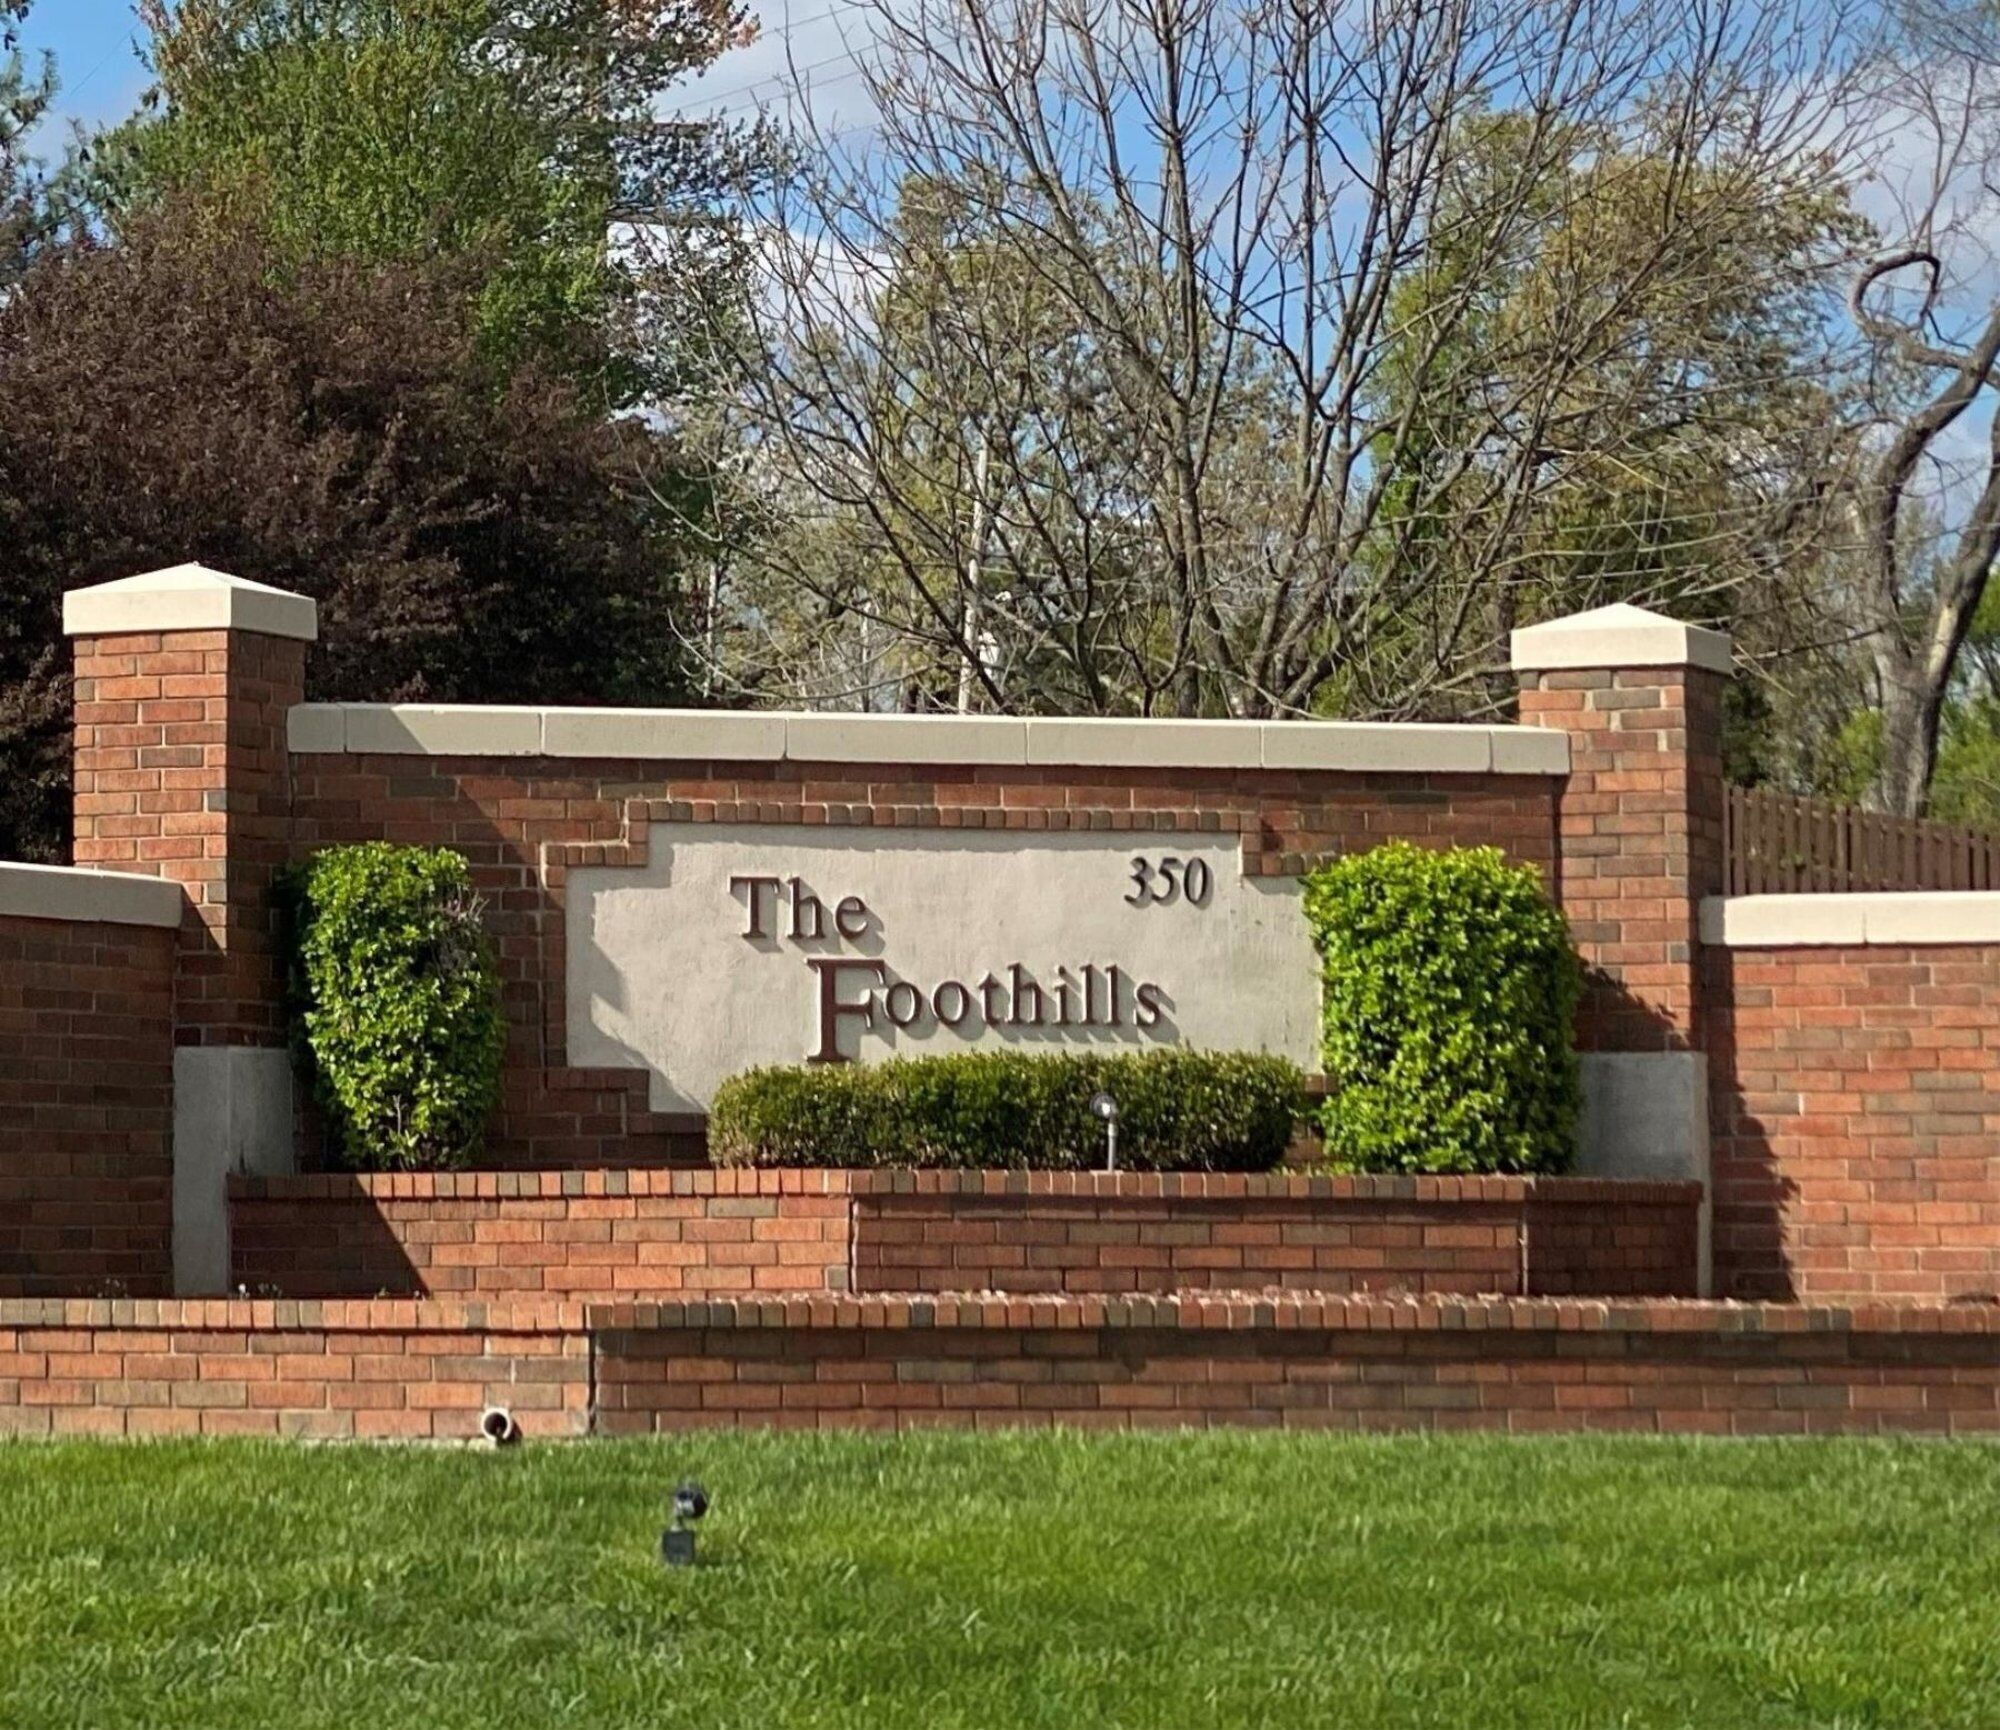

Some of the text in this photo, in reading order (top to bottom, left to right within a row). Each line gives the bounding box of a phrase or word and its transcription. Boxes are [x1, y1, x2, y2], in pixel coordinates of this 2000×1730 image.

[730, 876, 869, 941] The
[1124, 856, 1209, 905] 350
[806, 958, 1163, 1061] Foothills
